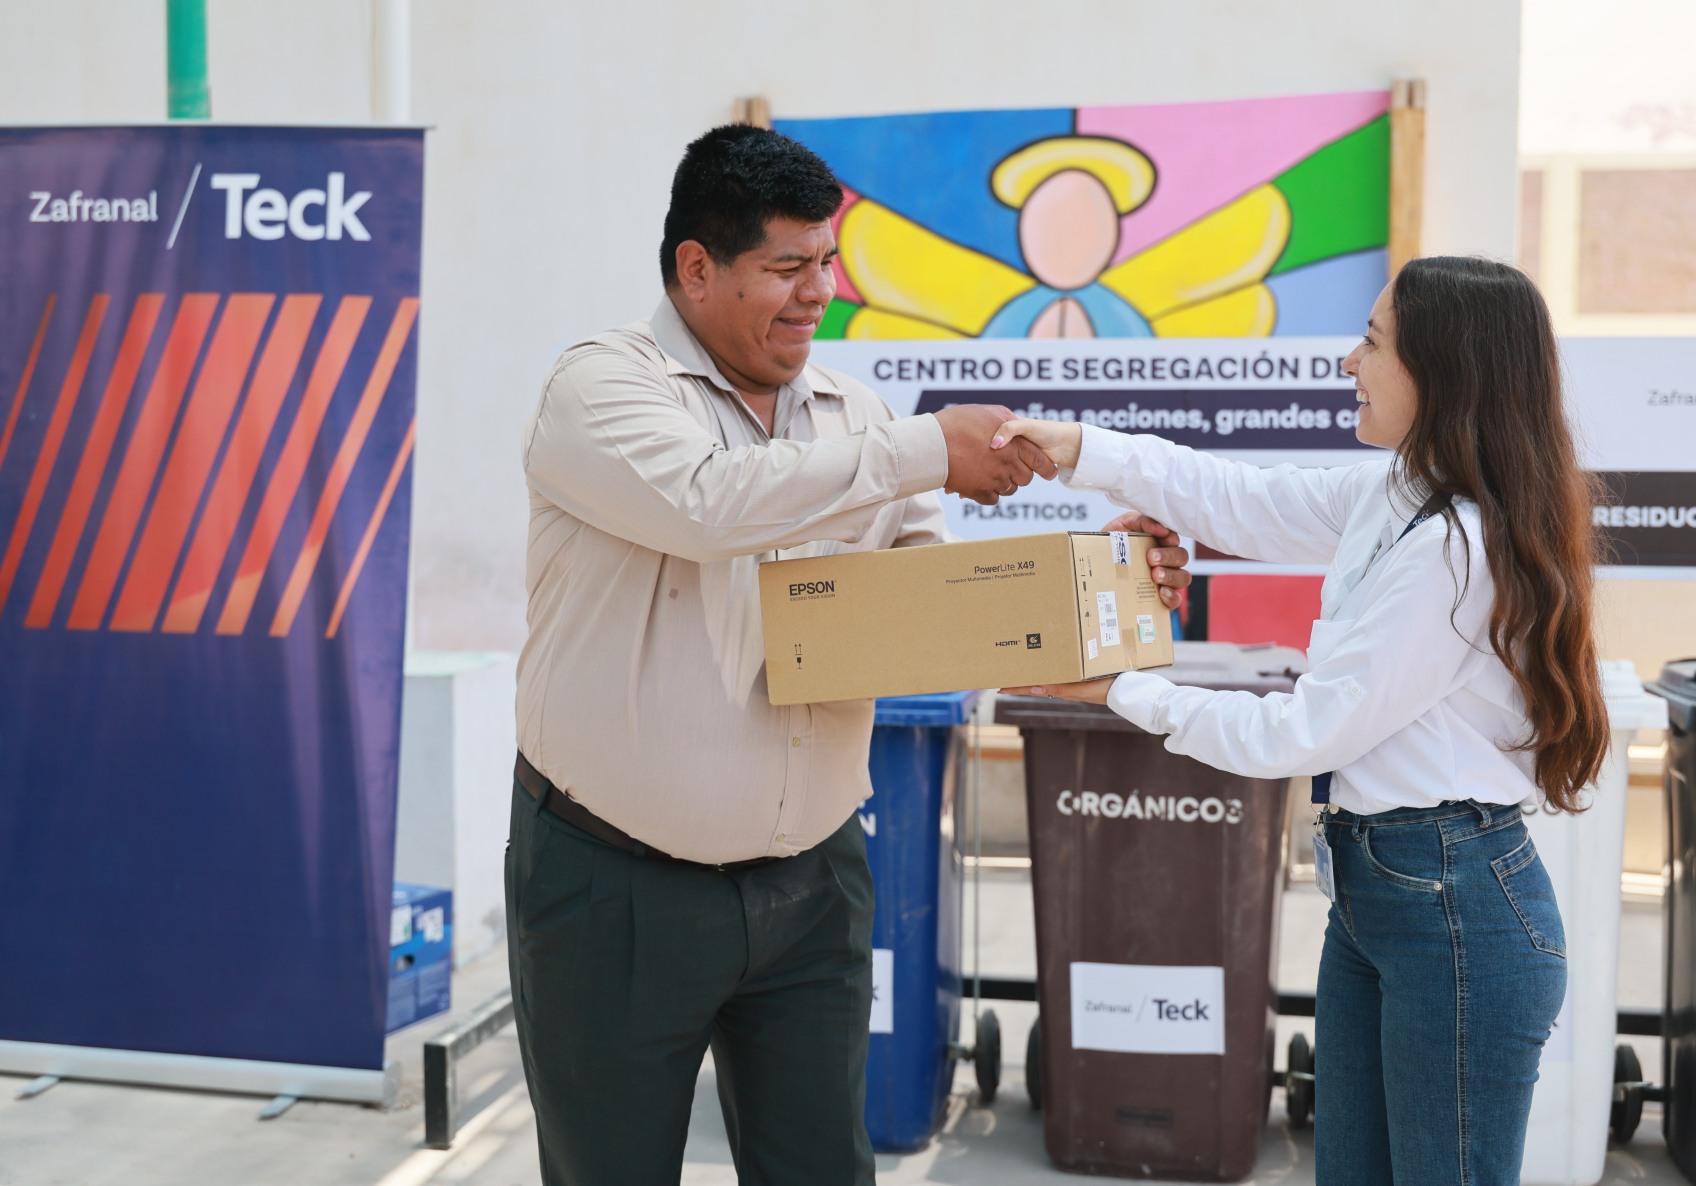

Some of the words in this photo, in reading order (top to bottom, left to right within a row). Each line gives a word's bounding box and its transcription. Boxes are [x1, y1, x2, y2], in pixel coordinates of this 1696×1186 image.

[29, 190, 159, 223] Zafranal
[210, 171, 373, 242] Teck
[873, 358, 1003, 381] CENTRO
[1013, 358, 1052, 381] DE
[1062, 351, 1299, 382] SEGREGACIÓN
[1647, 388, 1696, 407] Zafra
[1079, 402, 1211, 434] acciones,
[1215, 402, 1332, 436] grandes
[974, 563, 1016, 575] PowerLite
[1017, 560, 1035, 571] X49
[789, 580, 835, 596] EPSON
[995, 639, 1018, 647] HDMI
[1056, 789, 1244, 825] ORGÁNICOS
[1152, 997, 1209, 1021] Teck
